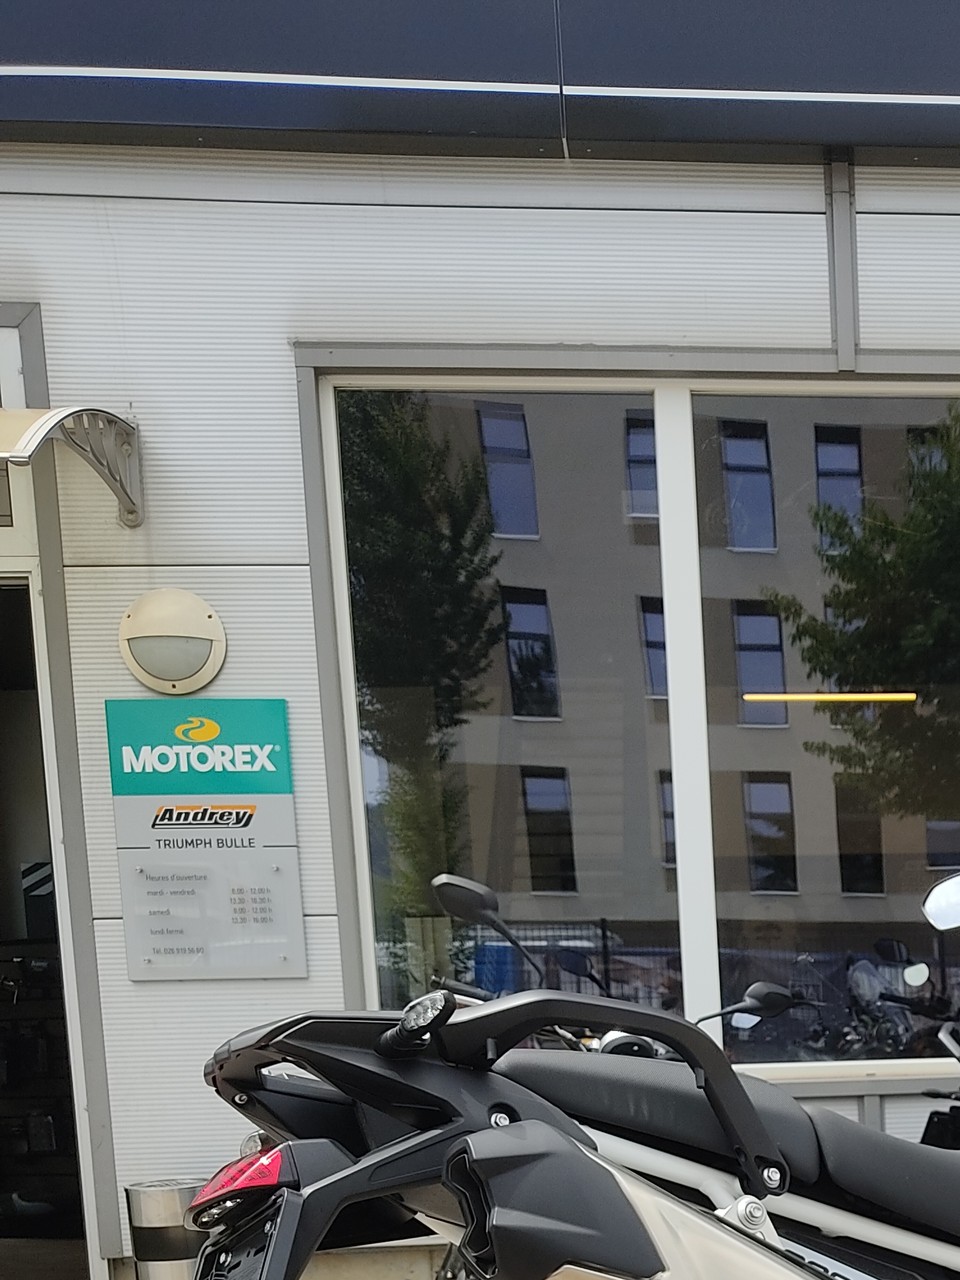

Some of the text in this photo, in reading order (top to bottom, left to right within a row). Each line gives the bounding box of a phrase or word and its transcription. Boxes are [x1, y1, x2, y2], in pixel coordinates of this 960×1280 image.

[121, 744, 277, 773] MOTOREX
[157, 807, 250, 828] Andrey
[156, 837, 256, 850] TRIUMPH BULLE
